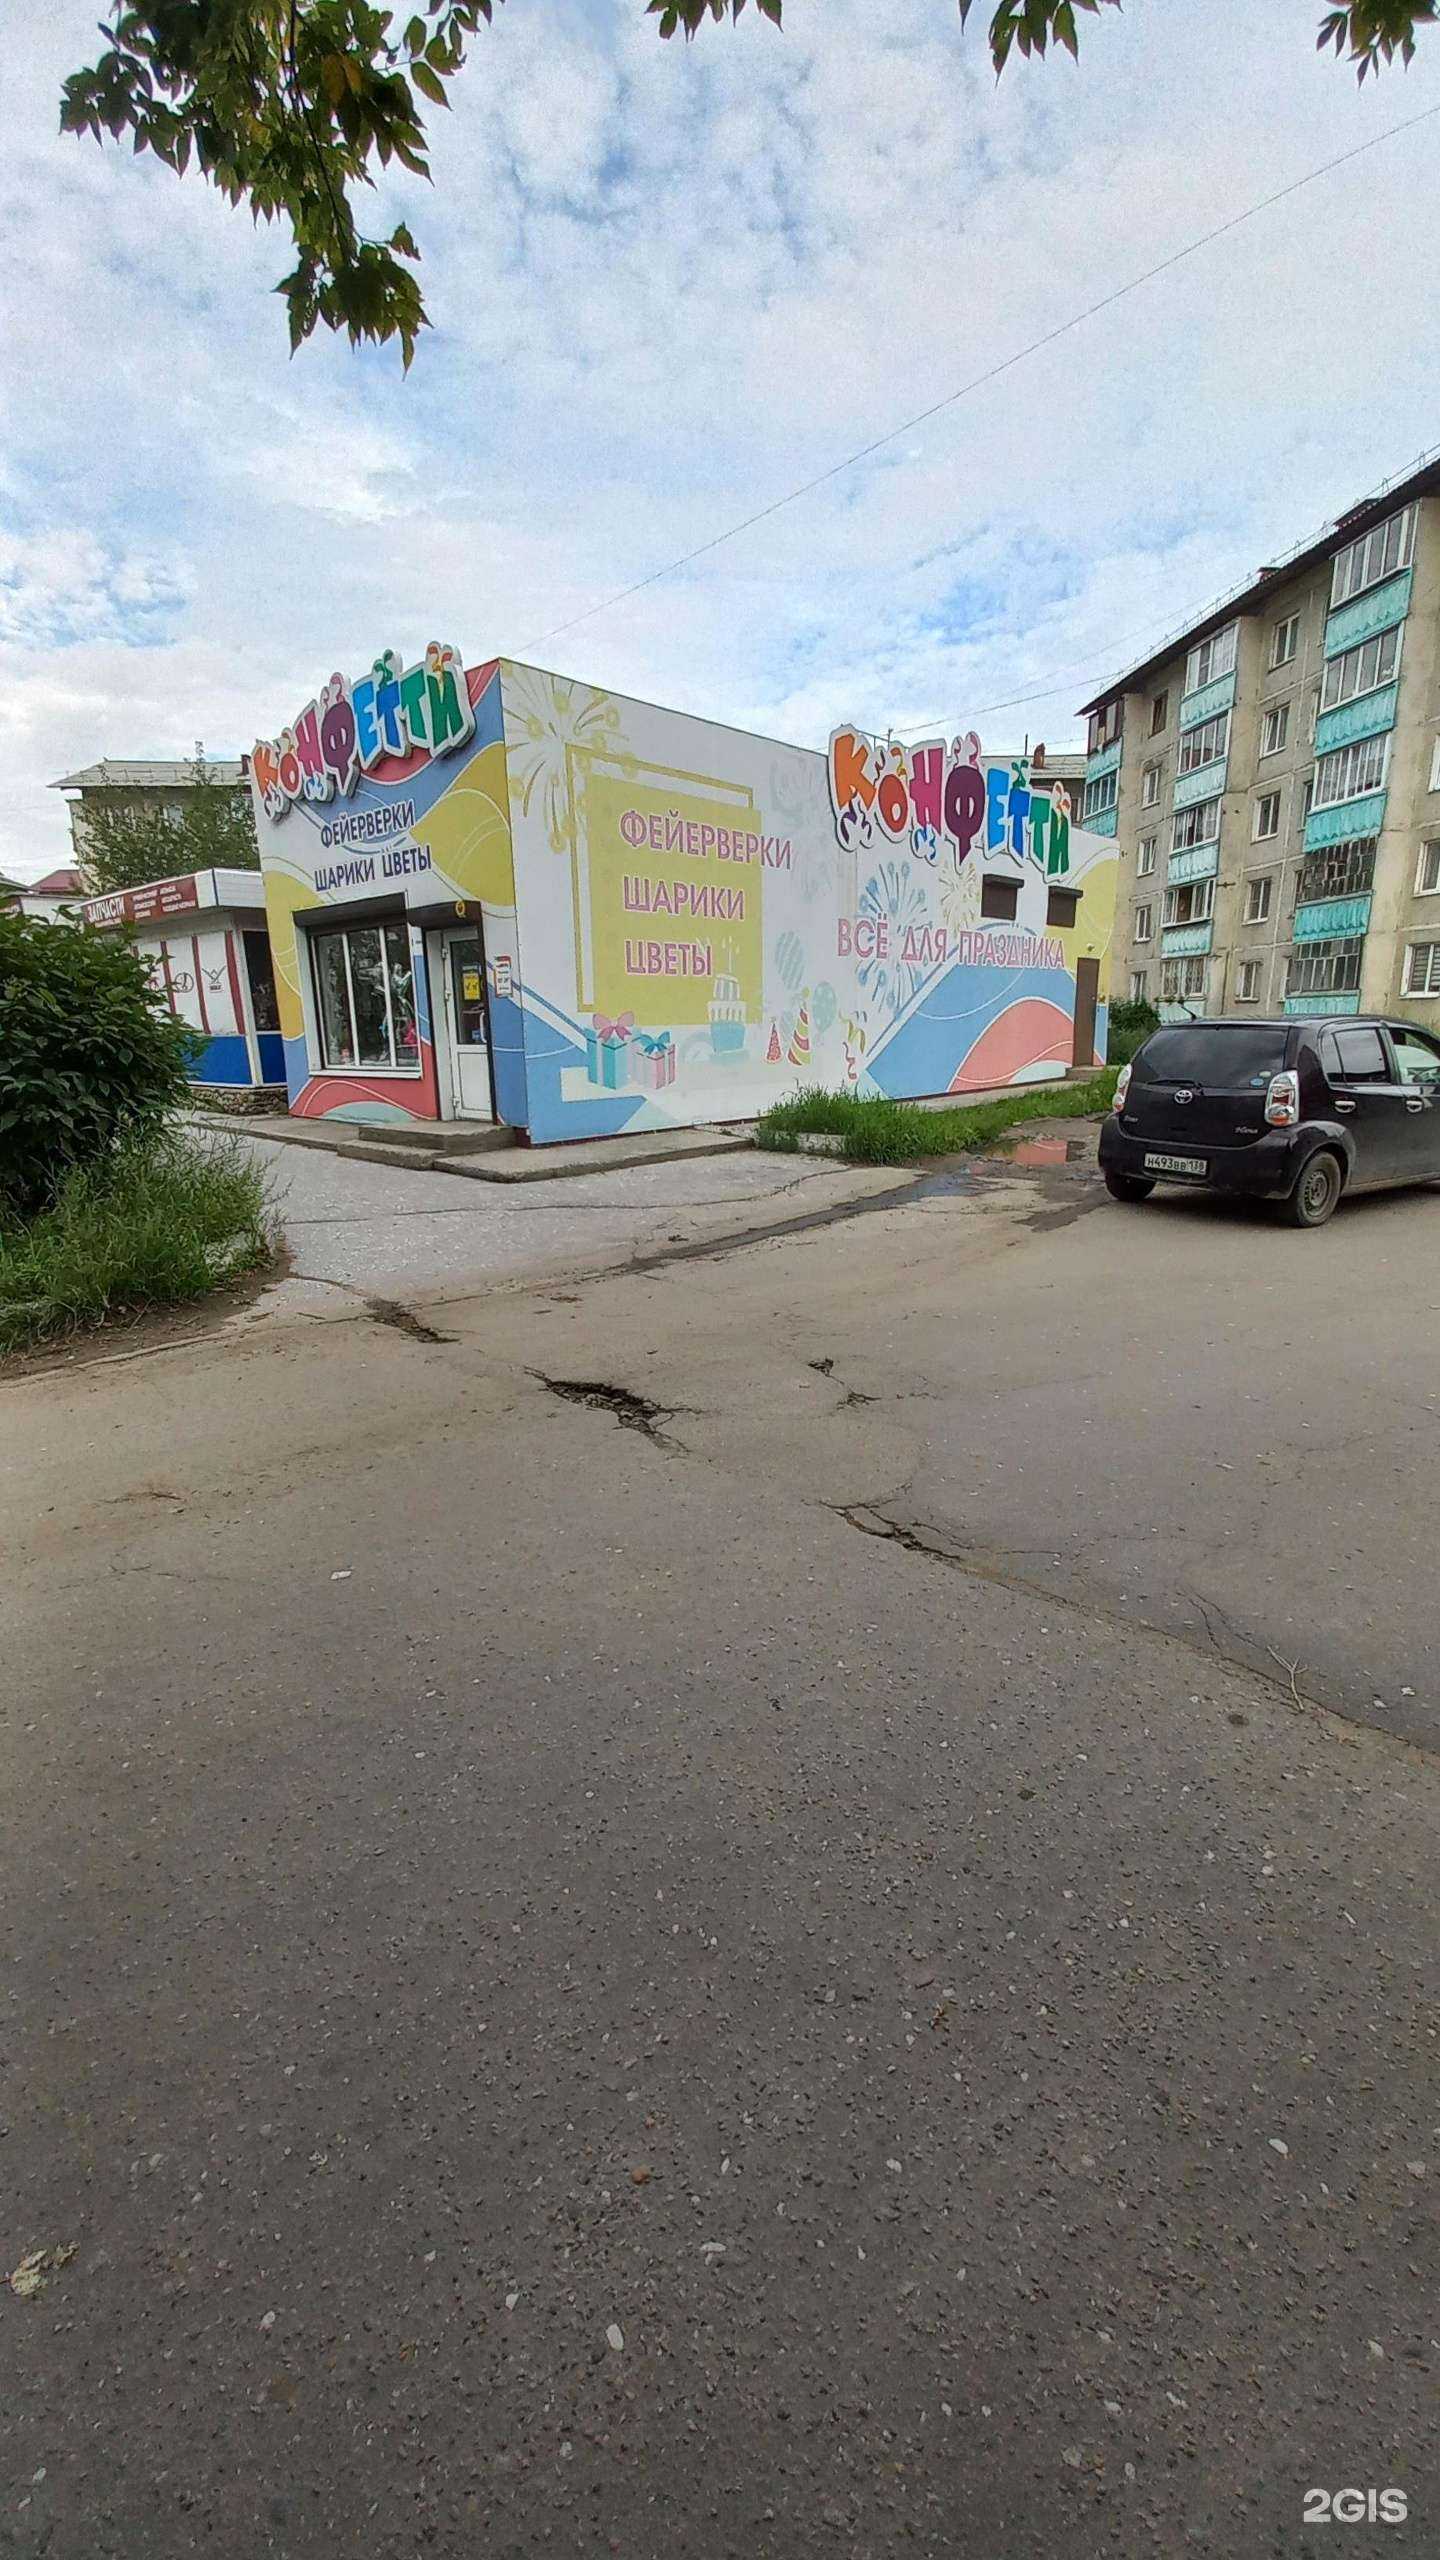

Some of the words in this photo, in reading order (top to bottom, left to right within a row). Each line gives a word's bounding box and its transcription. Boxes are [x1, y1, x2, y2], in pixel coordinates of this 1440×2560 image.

[253, 665, 465, 798] КОНФЕТТИ
[320, 800, 415, 849] ФЕЙЕРВЕРКИ
[834, 732, 1071, 877] КОНФЕТТИ
[620, 808, 792, 870] ФЕЙЕРВЕРКИ
[314, 857, 376, 892] ШАРИКИ
[381, 844, 432, 878] ЦВЕТЫ
[87, 895, 126, 923] ЗАПЧАСТИ
[623, 875, 745, 921] ШАРИКИ
[625, 939, 713, 977] ЦВЕТЫ
[837, 912, 889, 960] ВСЁ
[900, 925, 948, 962] ДЛЯ
[958, 929, 1066, 969] ПРАЗДНИКА
